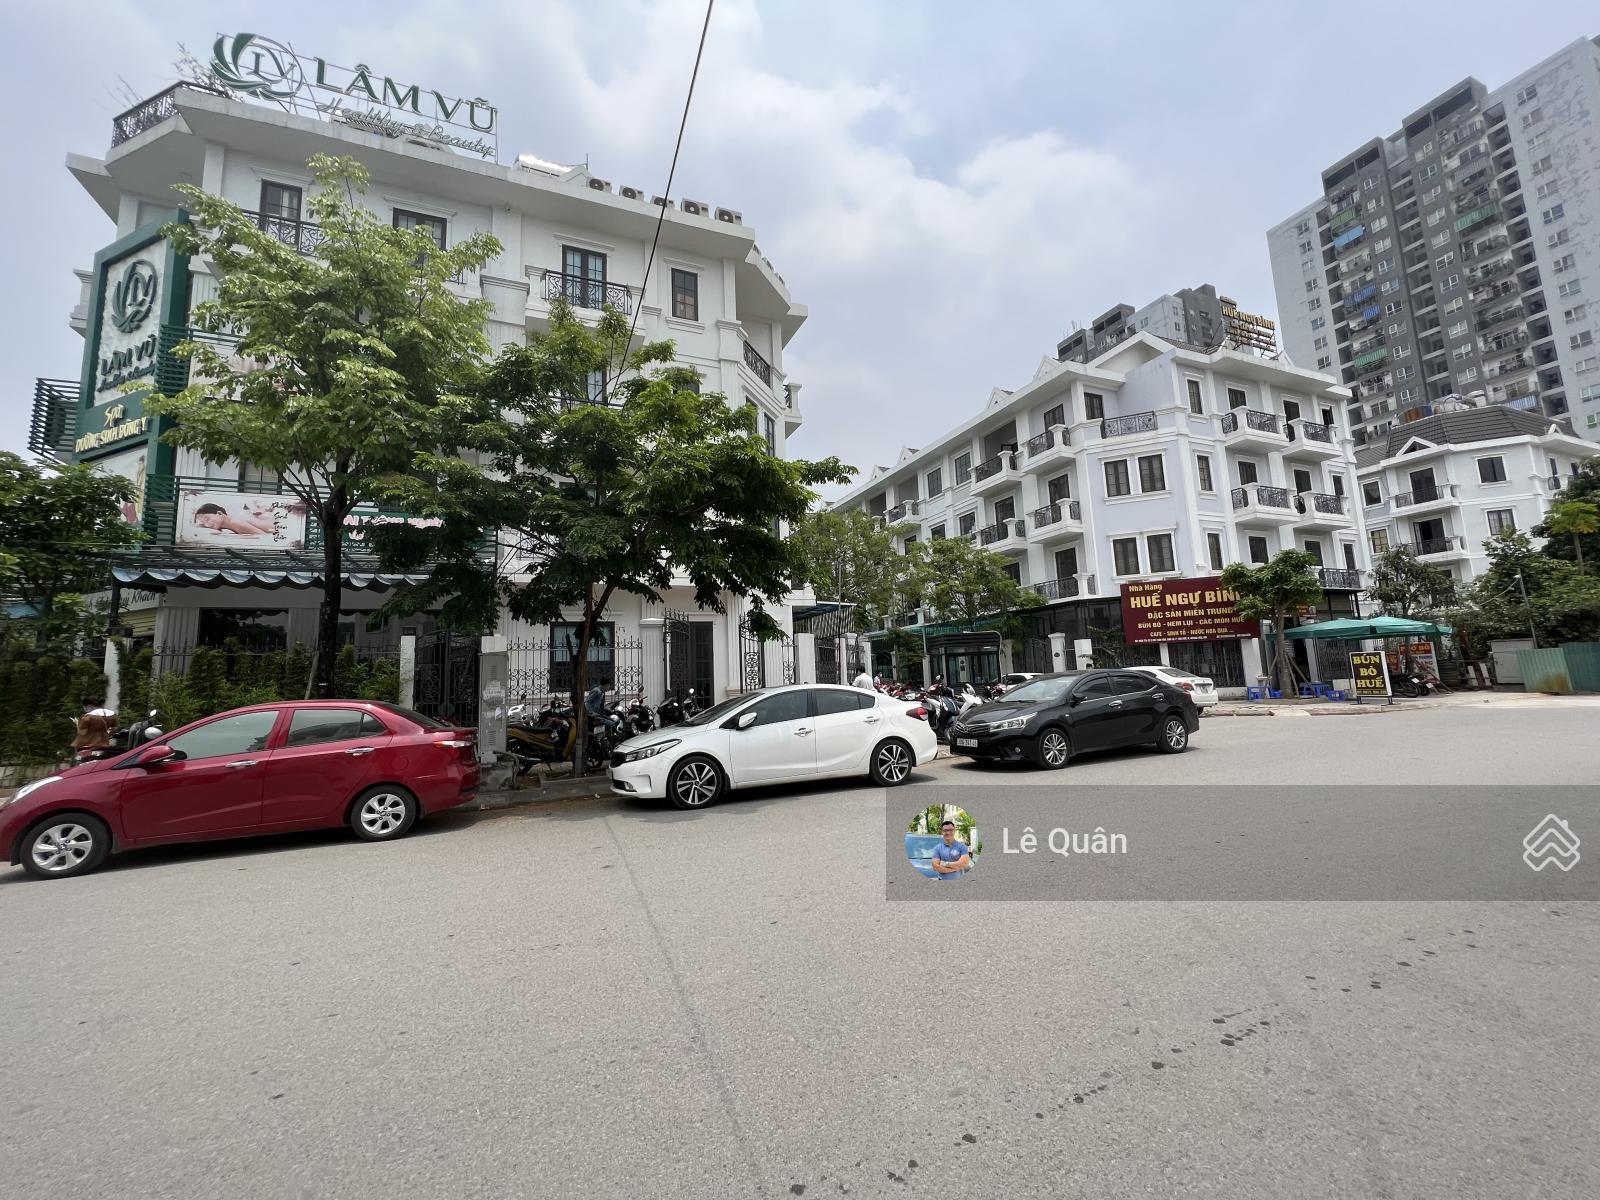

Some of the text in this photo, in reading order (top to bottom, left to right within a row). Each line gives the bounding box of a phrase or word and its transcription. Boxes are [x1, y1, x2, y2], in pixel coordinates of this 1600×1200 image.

[313, 56, 497, 132] LÂM VŨ
[141, 415, 149, 432] Y
[1130, 590, 1162, 609] HUẾ
[1165, 589, 1202, 608] NGỰ
[1352, 653, 1380, 665] BÚN
[1360, 665, 1378, 676] BÒ
[1356, 675, 1384, 688] HUẾ
